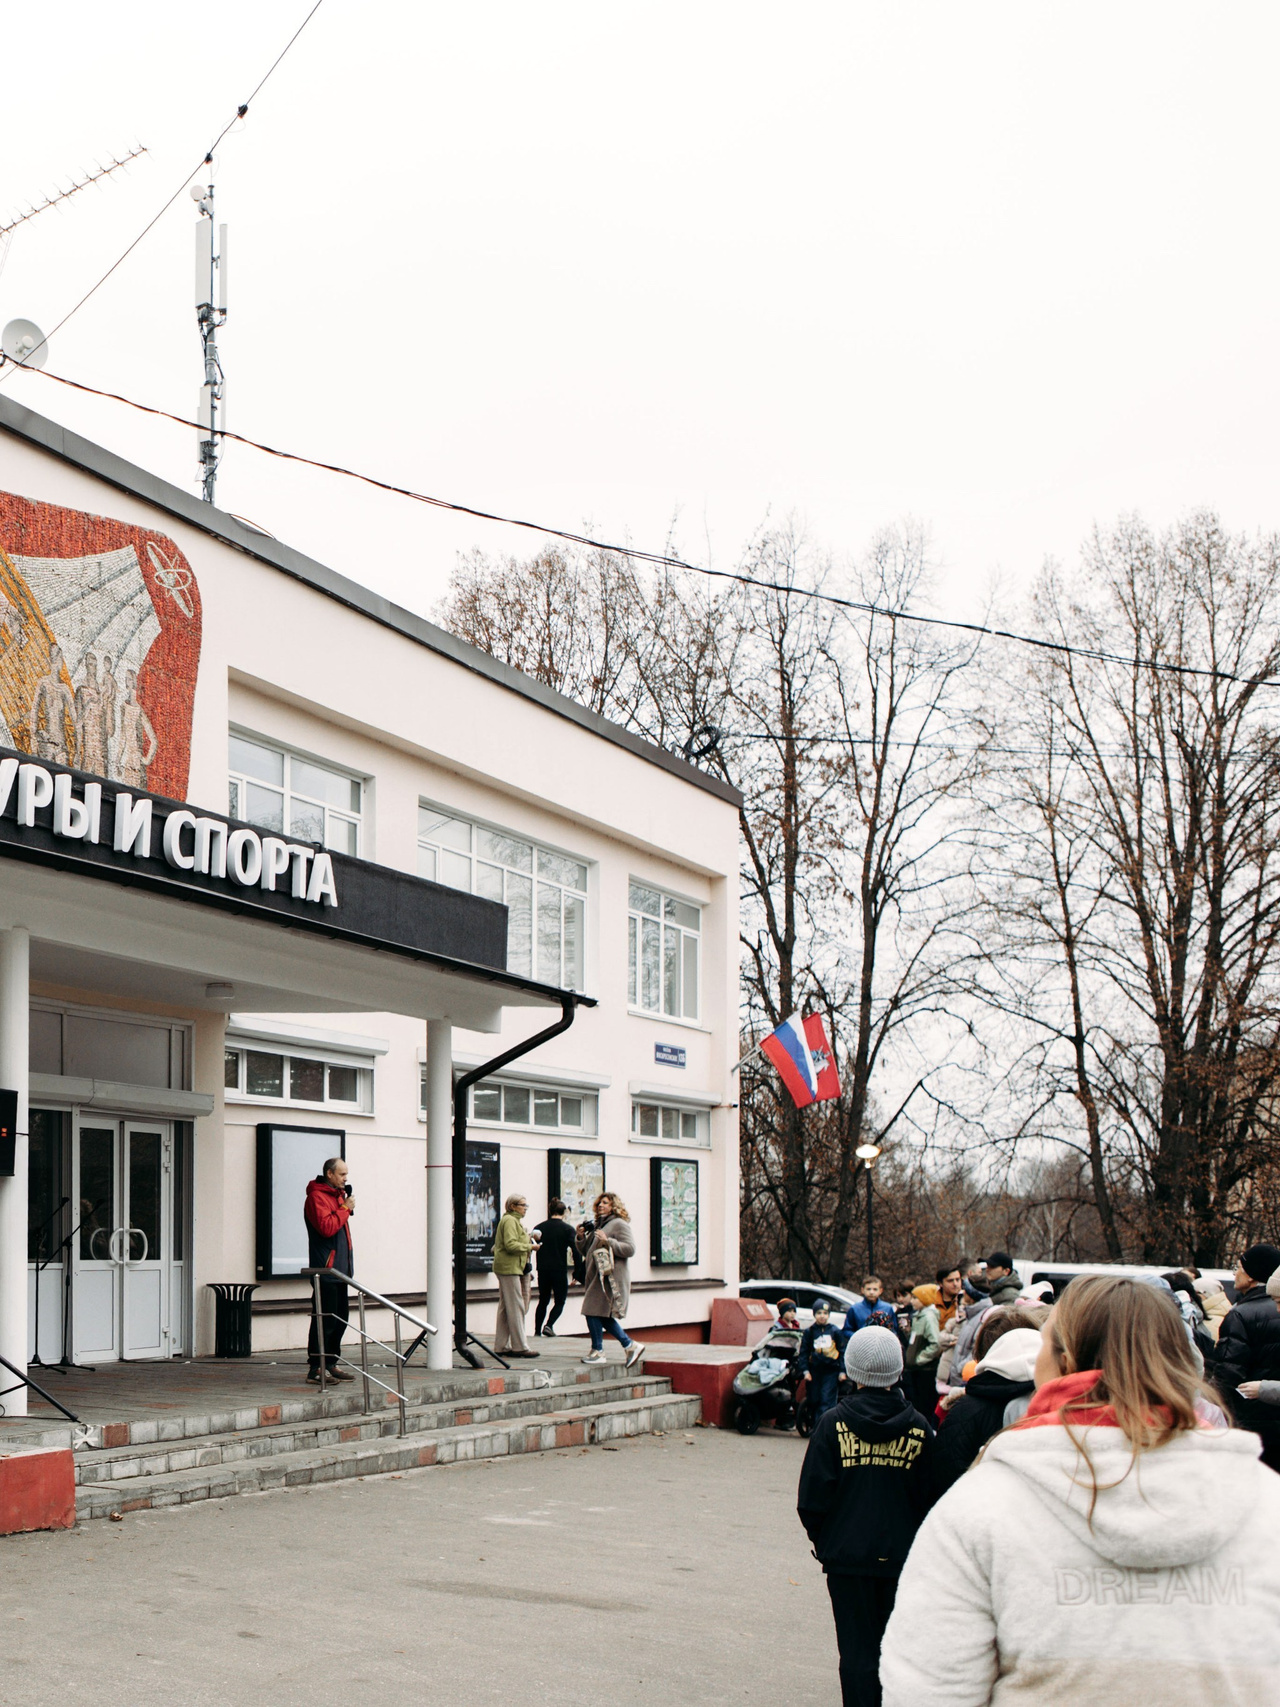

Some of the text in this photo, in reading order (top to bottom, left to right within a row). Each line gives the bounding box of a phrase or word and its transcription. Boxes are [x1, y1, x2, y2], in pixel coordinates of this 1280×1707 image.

[113, 792, 153, 858] И
[163, 809, 338, 908] СПОРТА
[1054, 1566, 1244, 1605] DREAM
